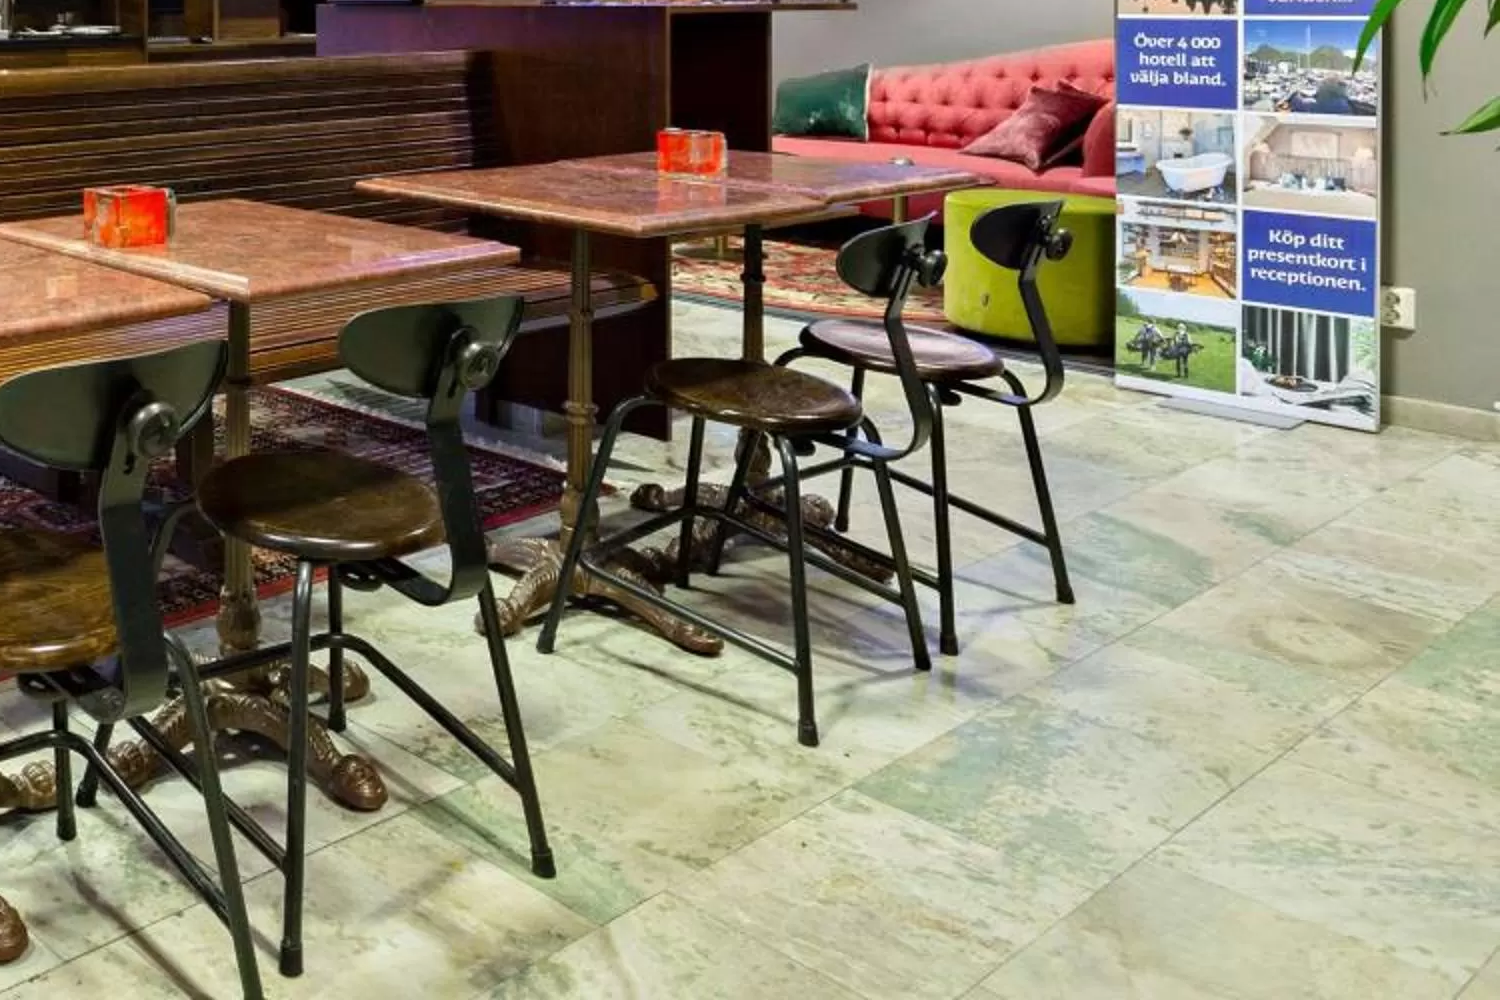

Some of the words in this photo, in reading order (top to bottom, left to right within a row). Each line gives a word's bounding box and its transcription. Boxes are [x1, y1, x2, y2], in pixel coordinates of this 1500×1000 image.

[1134, 31, 1174, 48] Över
[1176, 36, 1188, 49] 4
[1191, 36, 1222, 49] 000
[1139, 51, 1187, 67] hotell
[1191, 55, 1217, 67] att
[1129, 69, 1169, 87] välja
[1173, 71, 1227, 87] bland.
[1268, 229, 1306, 249] Köp
[1310, 233, 1345, 251] ditt
[1247, 248, 1357, 271] presentkort
[1361, 257, 1367, 272] i
[1250, 267, 1367, 292] receptionen.
